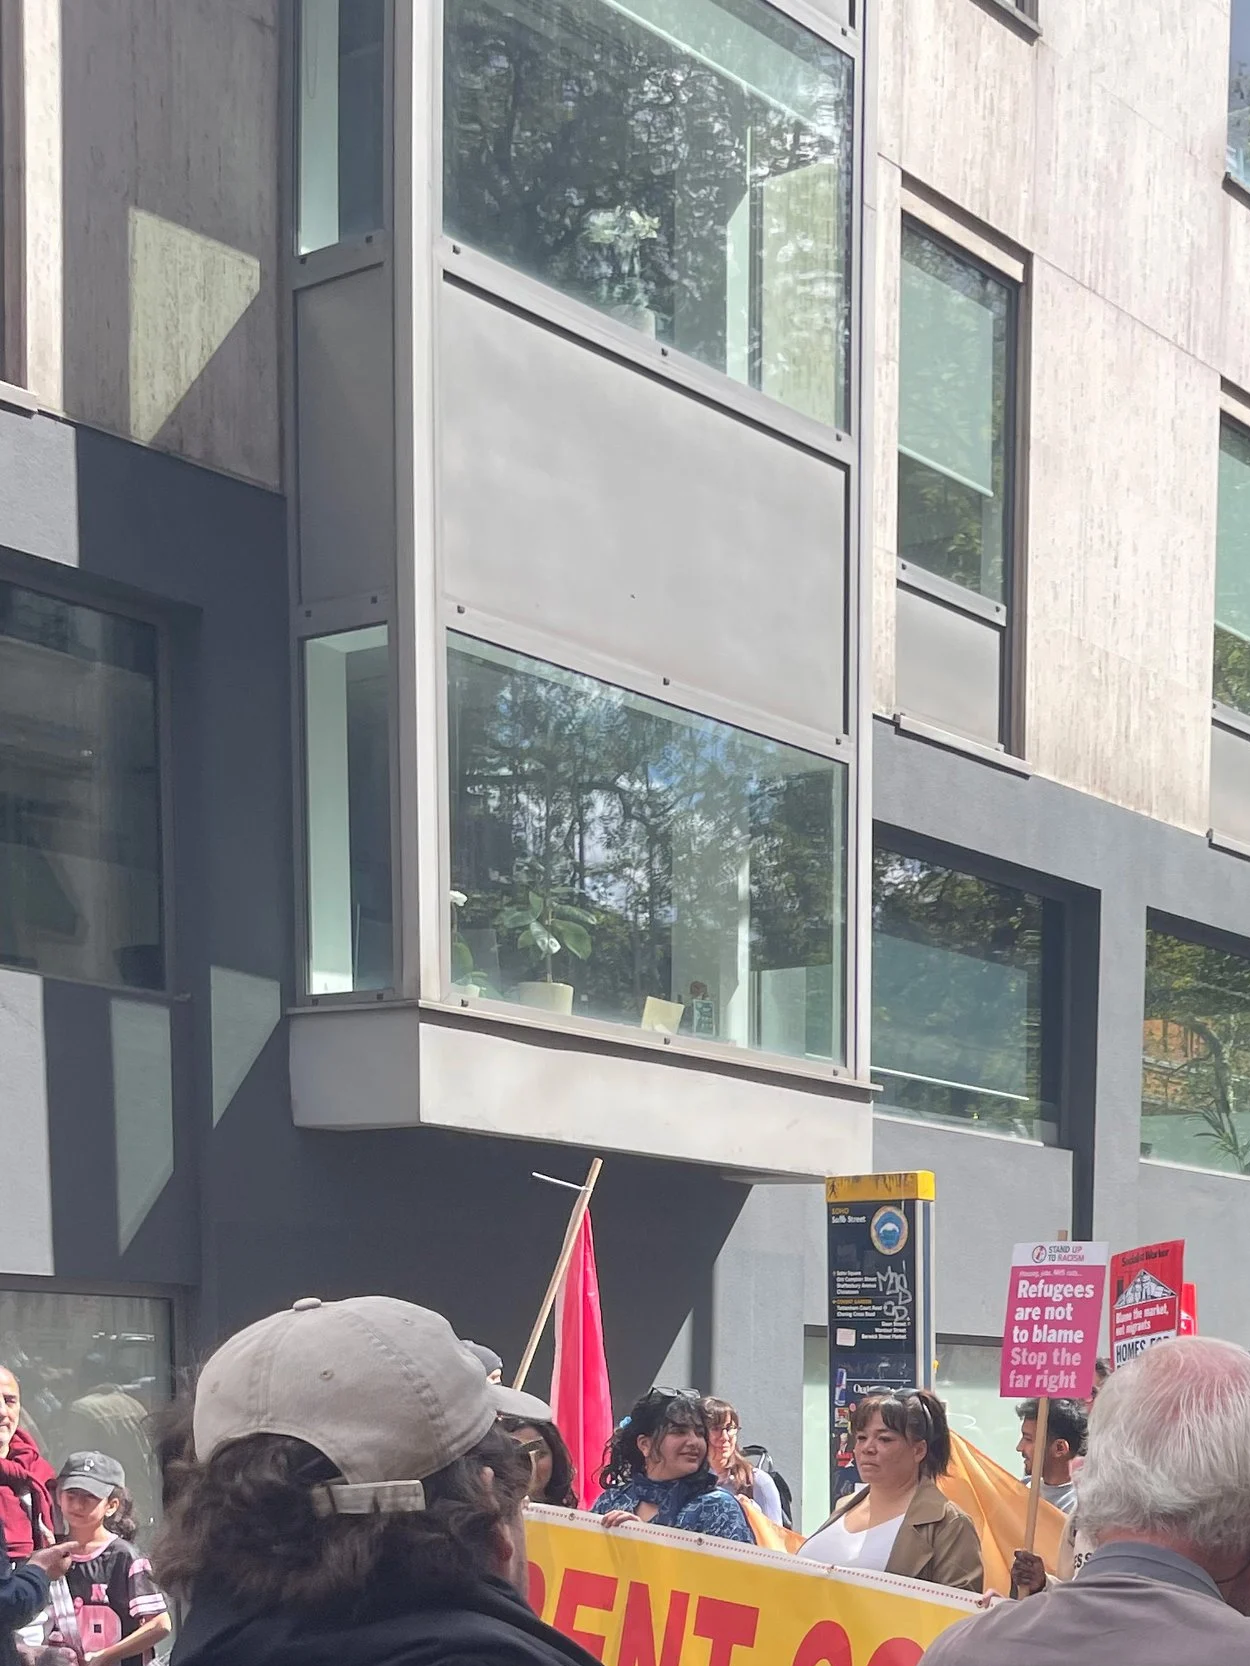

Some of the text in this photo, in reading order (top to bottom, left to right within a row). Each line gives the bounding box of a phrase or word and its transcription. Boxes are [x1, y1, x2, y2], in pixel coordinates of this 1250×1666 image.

[1049, 1245, 1083, 1254] STAND UP
[1058, 1254, 1084, 1262] RACISM
[1017, 1279, 1095, 1302] Refugees
[1014, 1303, 1074, 1321] are not
[1133, 1308, 1143, 1319] the
[1144, 1303, 1169, 1317] market,
[1012, 1324, 1084, 1344] to blame
[1010, 1347, 1081, 1370] Stop the
[1009, 1370, 1077, 1393] far right
